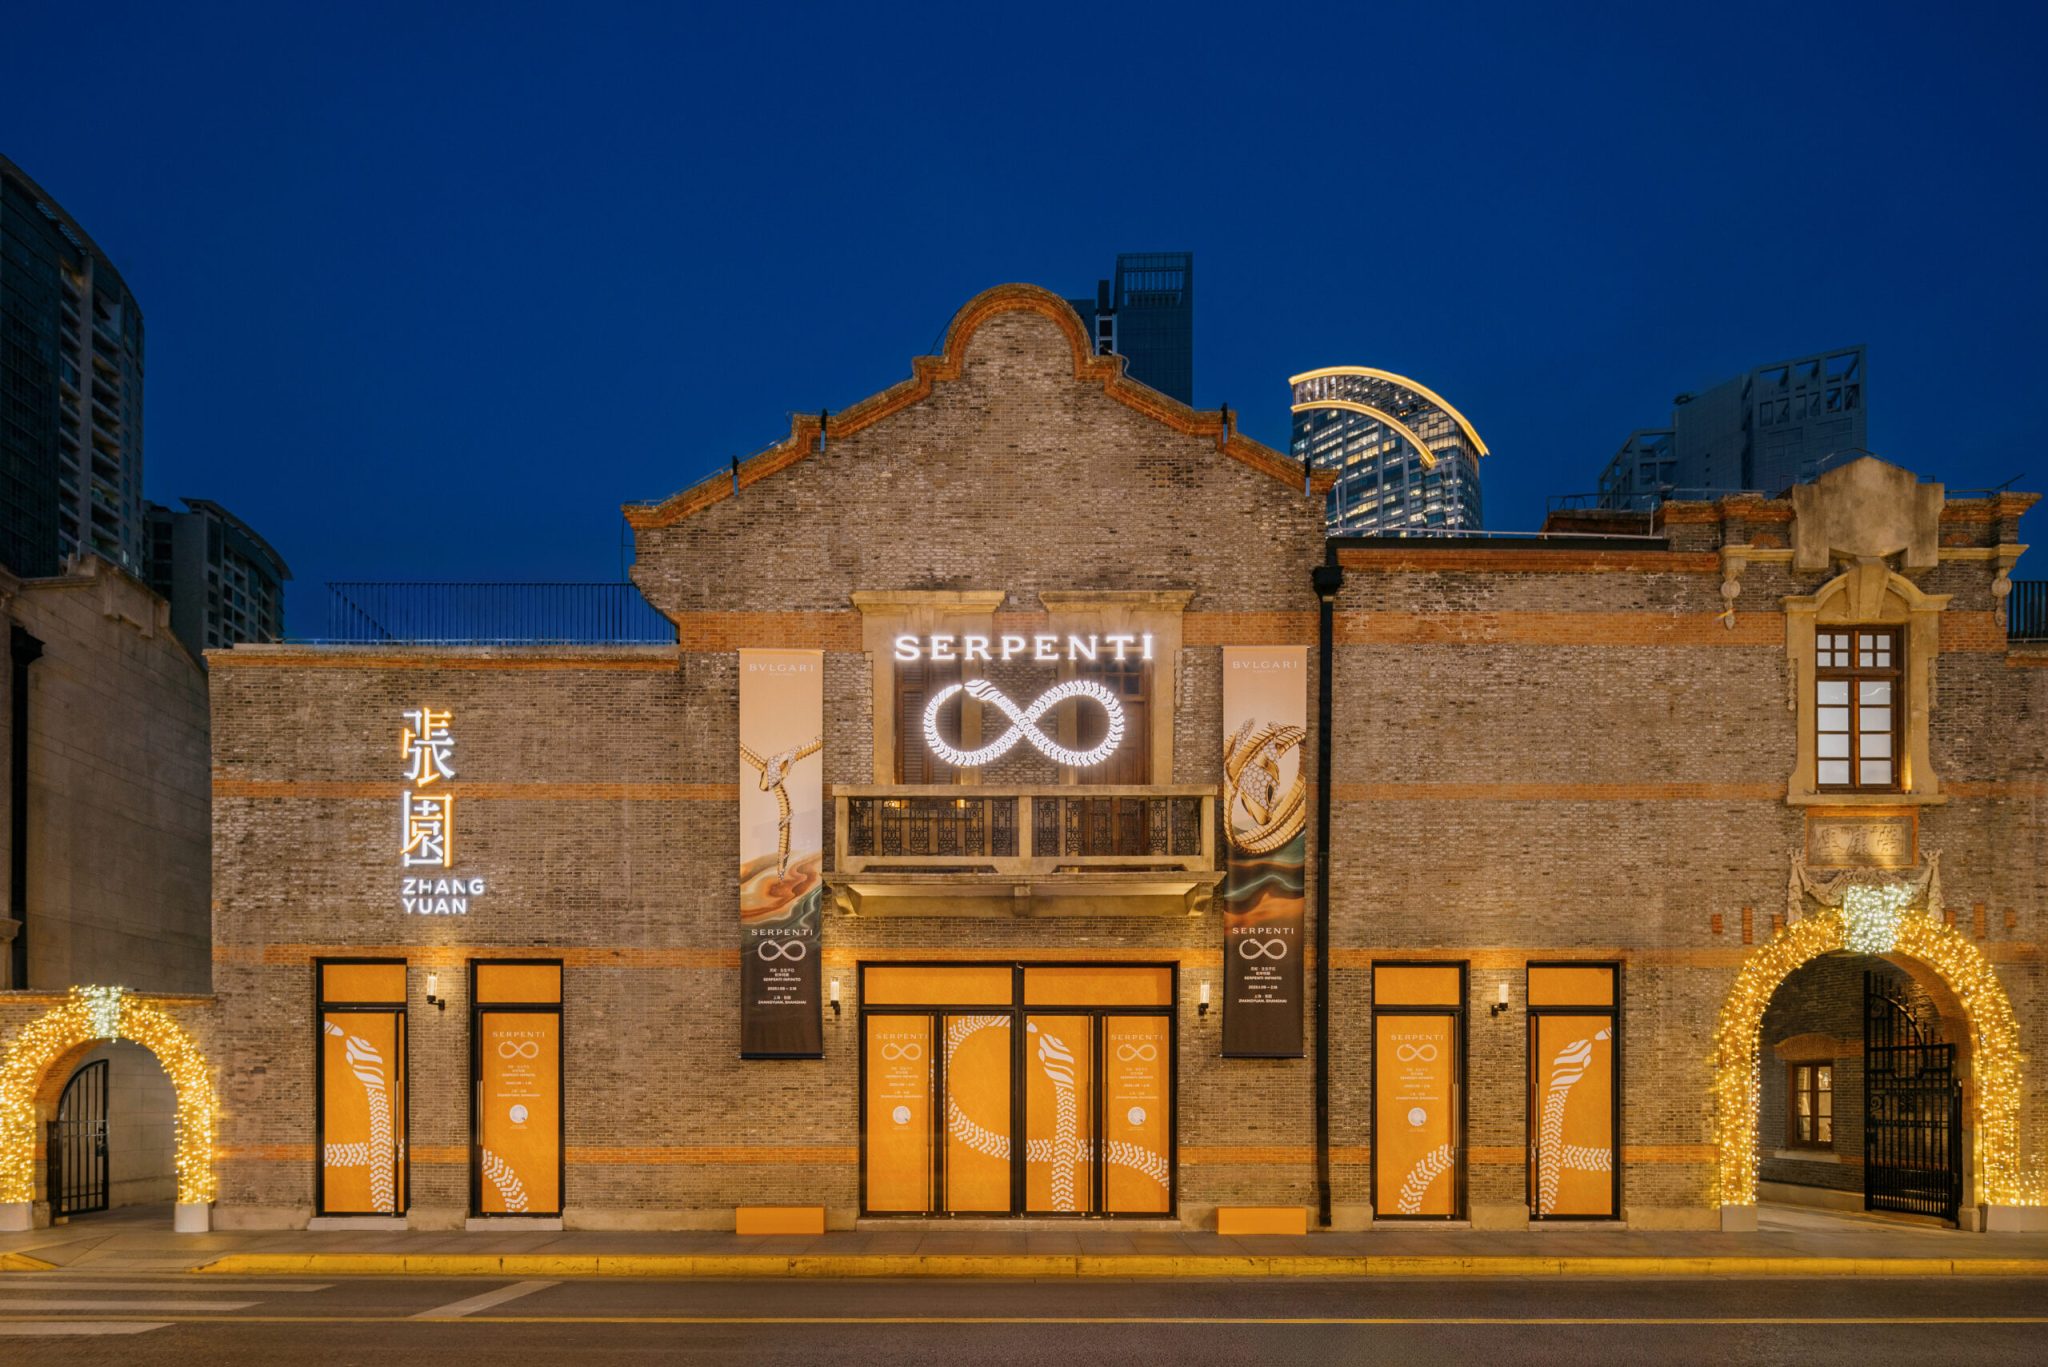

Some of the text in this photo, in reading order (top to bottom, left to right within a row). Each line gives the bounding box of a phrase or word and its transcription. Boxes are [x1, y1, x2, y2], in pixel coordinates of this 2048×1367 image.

[895, 635, 1154, 662] SERPENTI
[749, 663, 814, 672] BVLGARI
[1232, 660, 1297, 669] BVLGARI
[400, 707, 456, 868] 張園
[402, 879, 485, 895] ZHANG
[402, 898, 467, 914] YUAN
